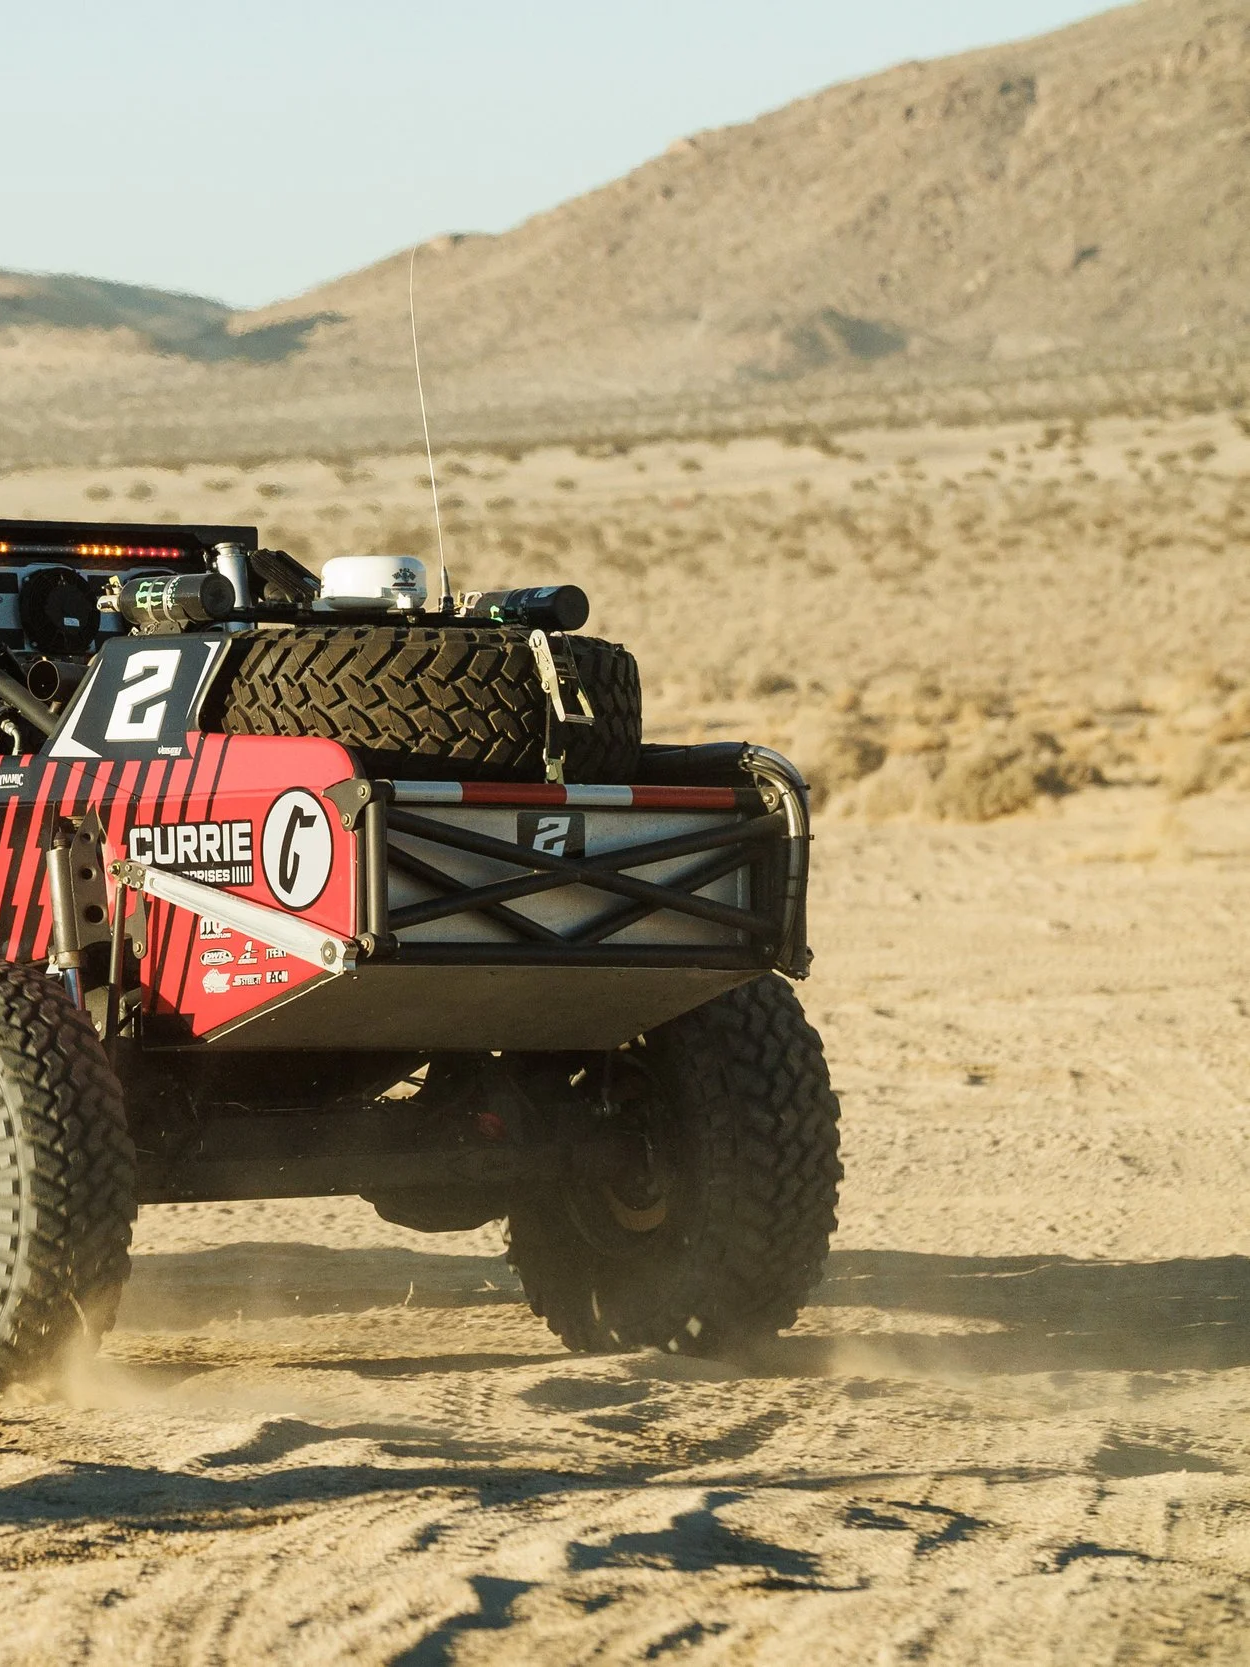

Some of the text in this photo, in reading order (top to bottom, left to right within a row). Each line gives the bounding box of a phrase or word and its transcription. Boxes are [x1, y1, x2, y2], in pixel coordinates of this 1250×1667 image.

[105, 649, 182, 742] 2
[130, 822, 252, 865] CURRIE
[533, 817, 570, 857] 2
[266, 970, 289, 983] EATON
